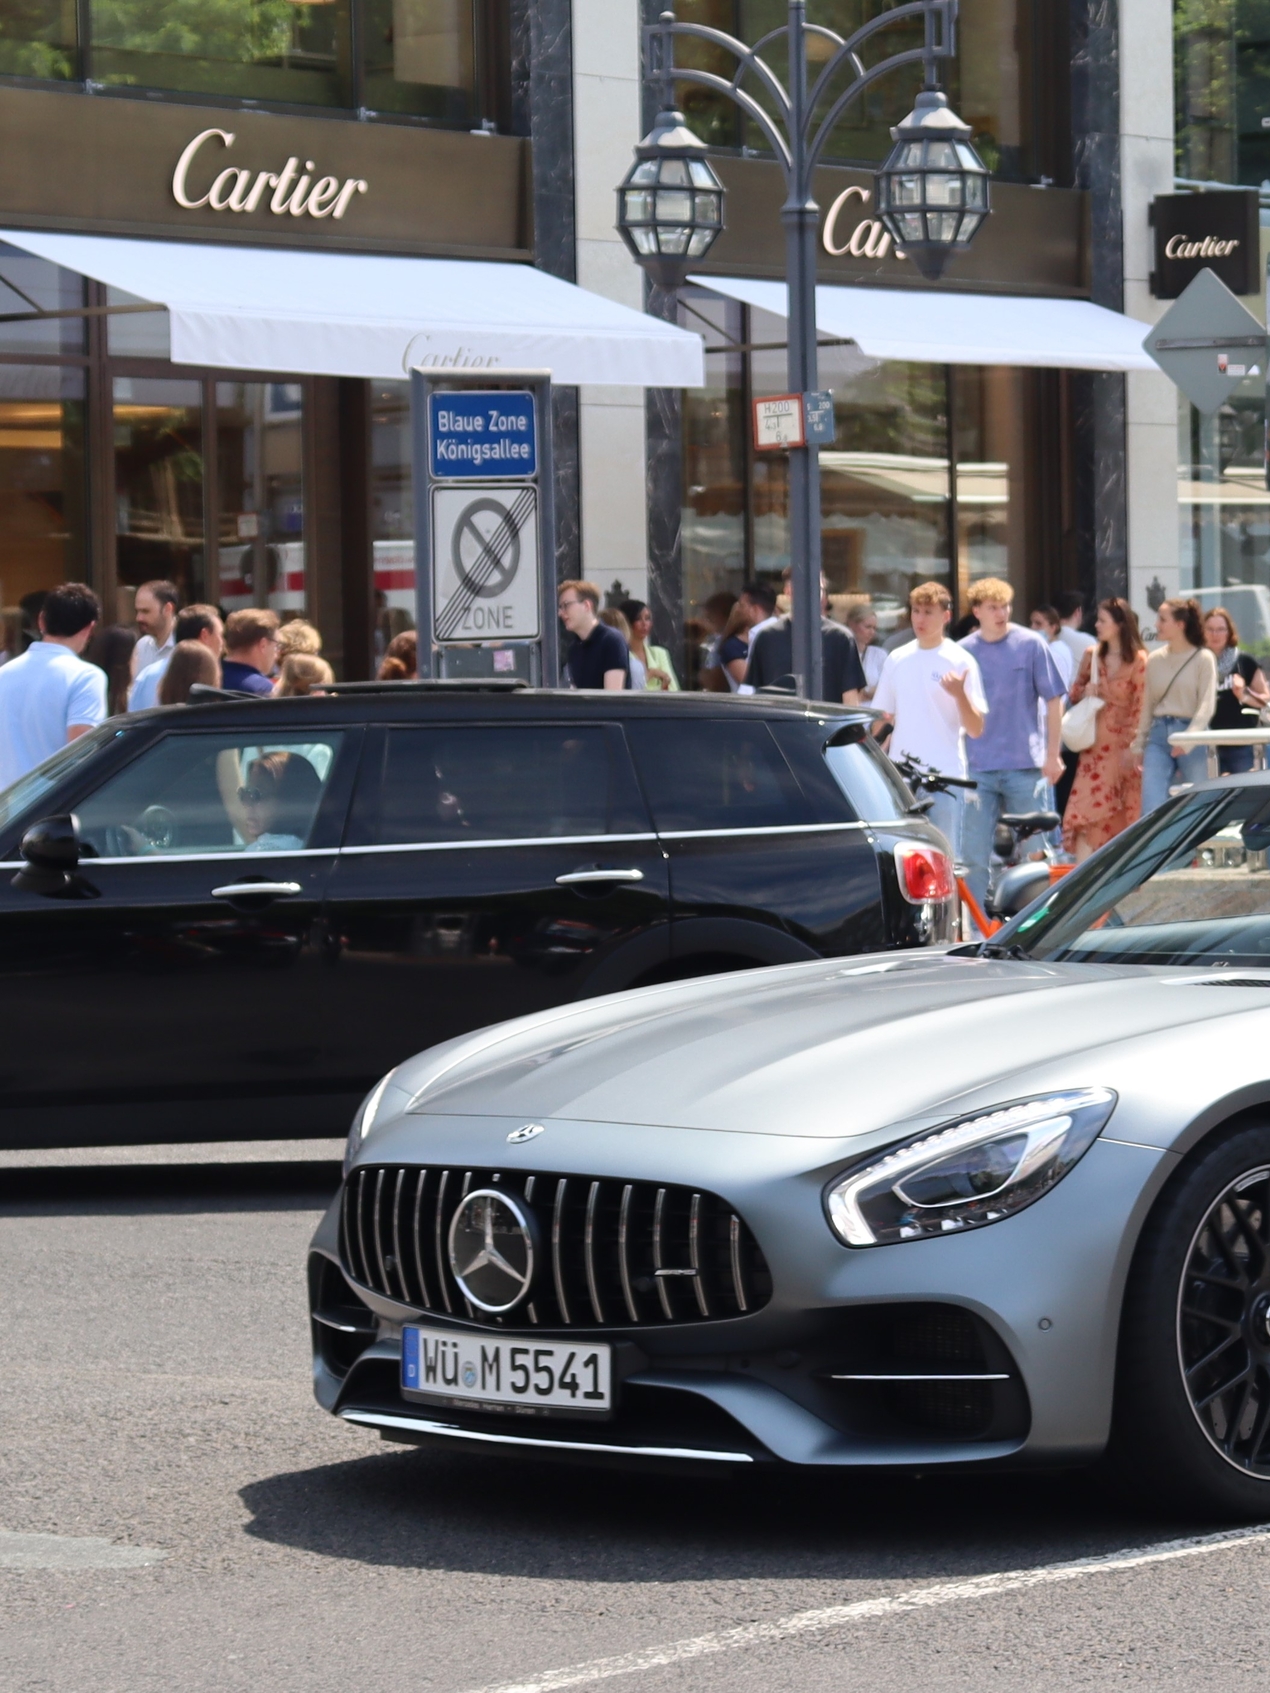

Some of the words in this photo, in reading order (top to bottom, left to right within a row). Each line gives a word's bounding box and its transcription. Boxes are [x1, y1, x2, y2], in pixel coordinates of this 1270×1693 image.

[173, 128, 368, 219] Cartier
[1165, 234, 1239, 259] Cartier
[438, 411, 483, 432] Blaue
[488, 410, 527, 432] Zone
[437, 439, 529, 466] Königsallee
[462, 605, 514, 630] ZONE
[481, 1345, 500, 1391] M
[510, 1347, 604, 1400] 5541
